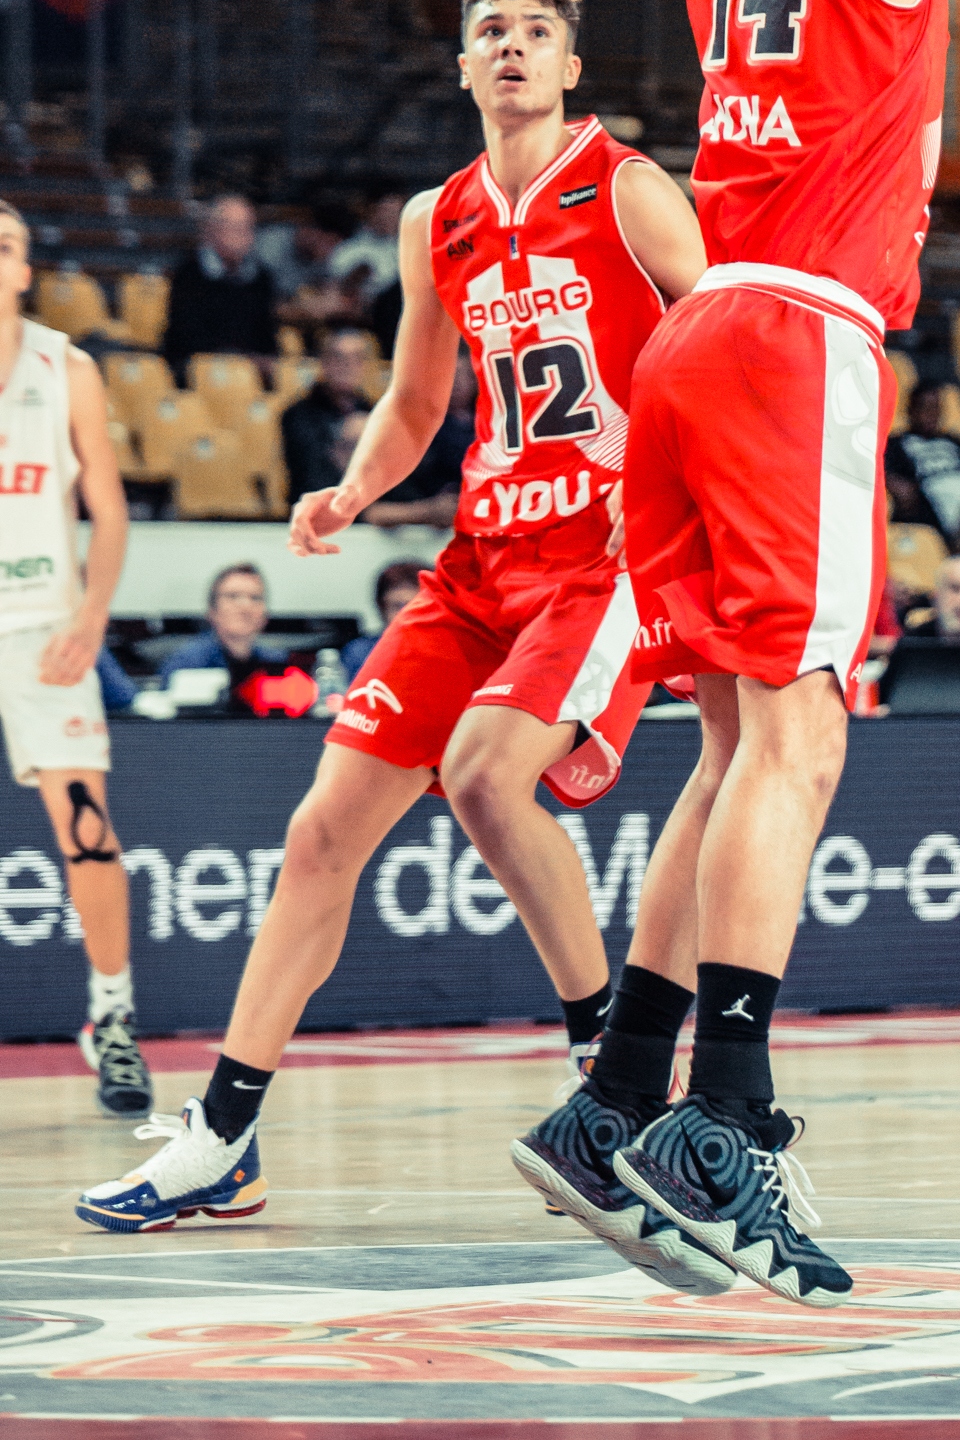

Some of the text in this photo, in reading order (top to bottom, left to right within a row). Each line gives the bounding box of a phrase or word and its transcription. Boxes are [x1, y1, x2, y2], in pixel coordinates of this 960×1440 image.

[467, 279, 591, 334] BOURG
[489, 337, 602, 453] 12
[374, 815, 518, 936] de
